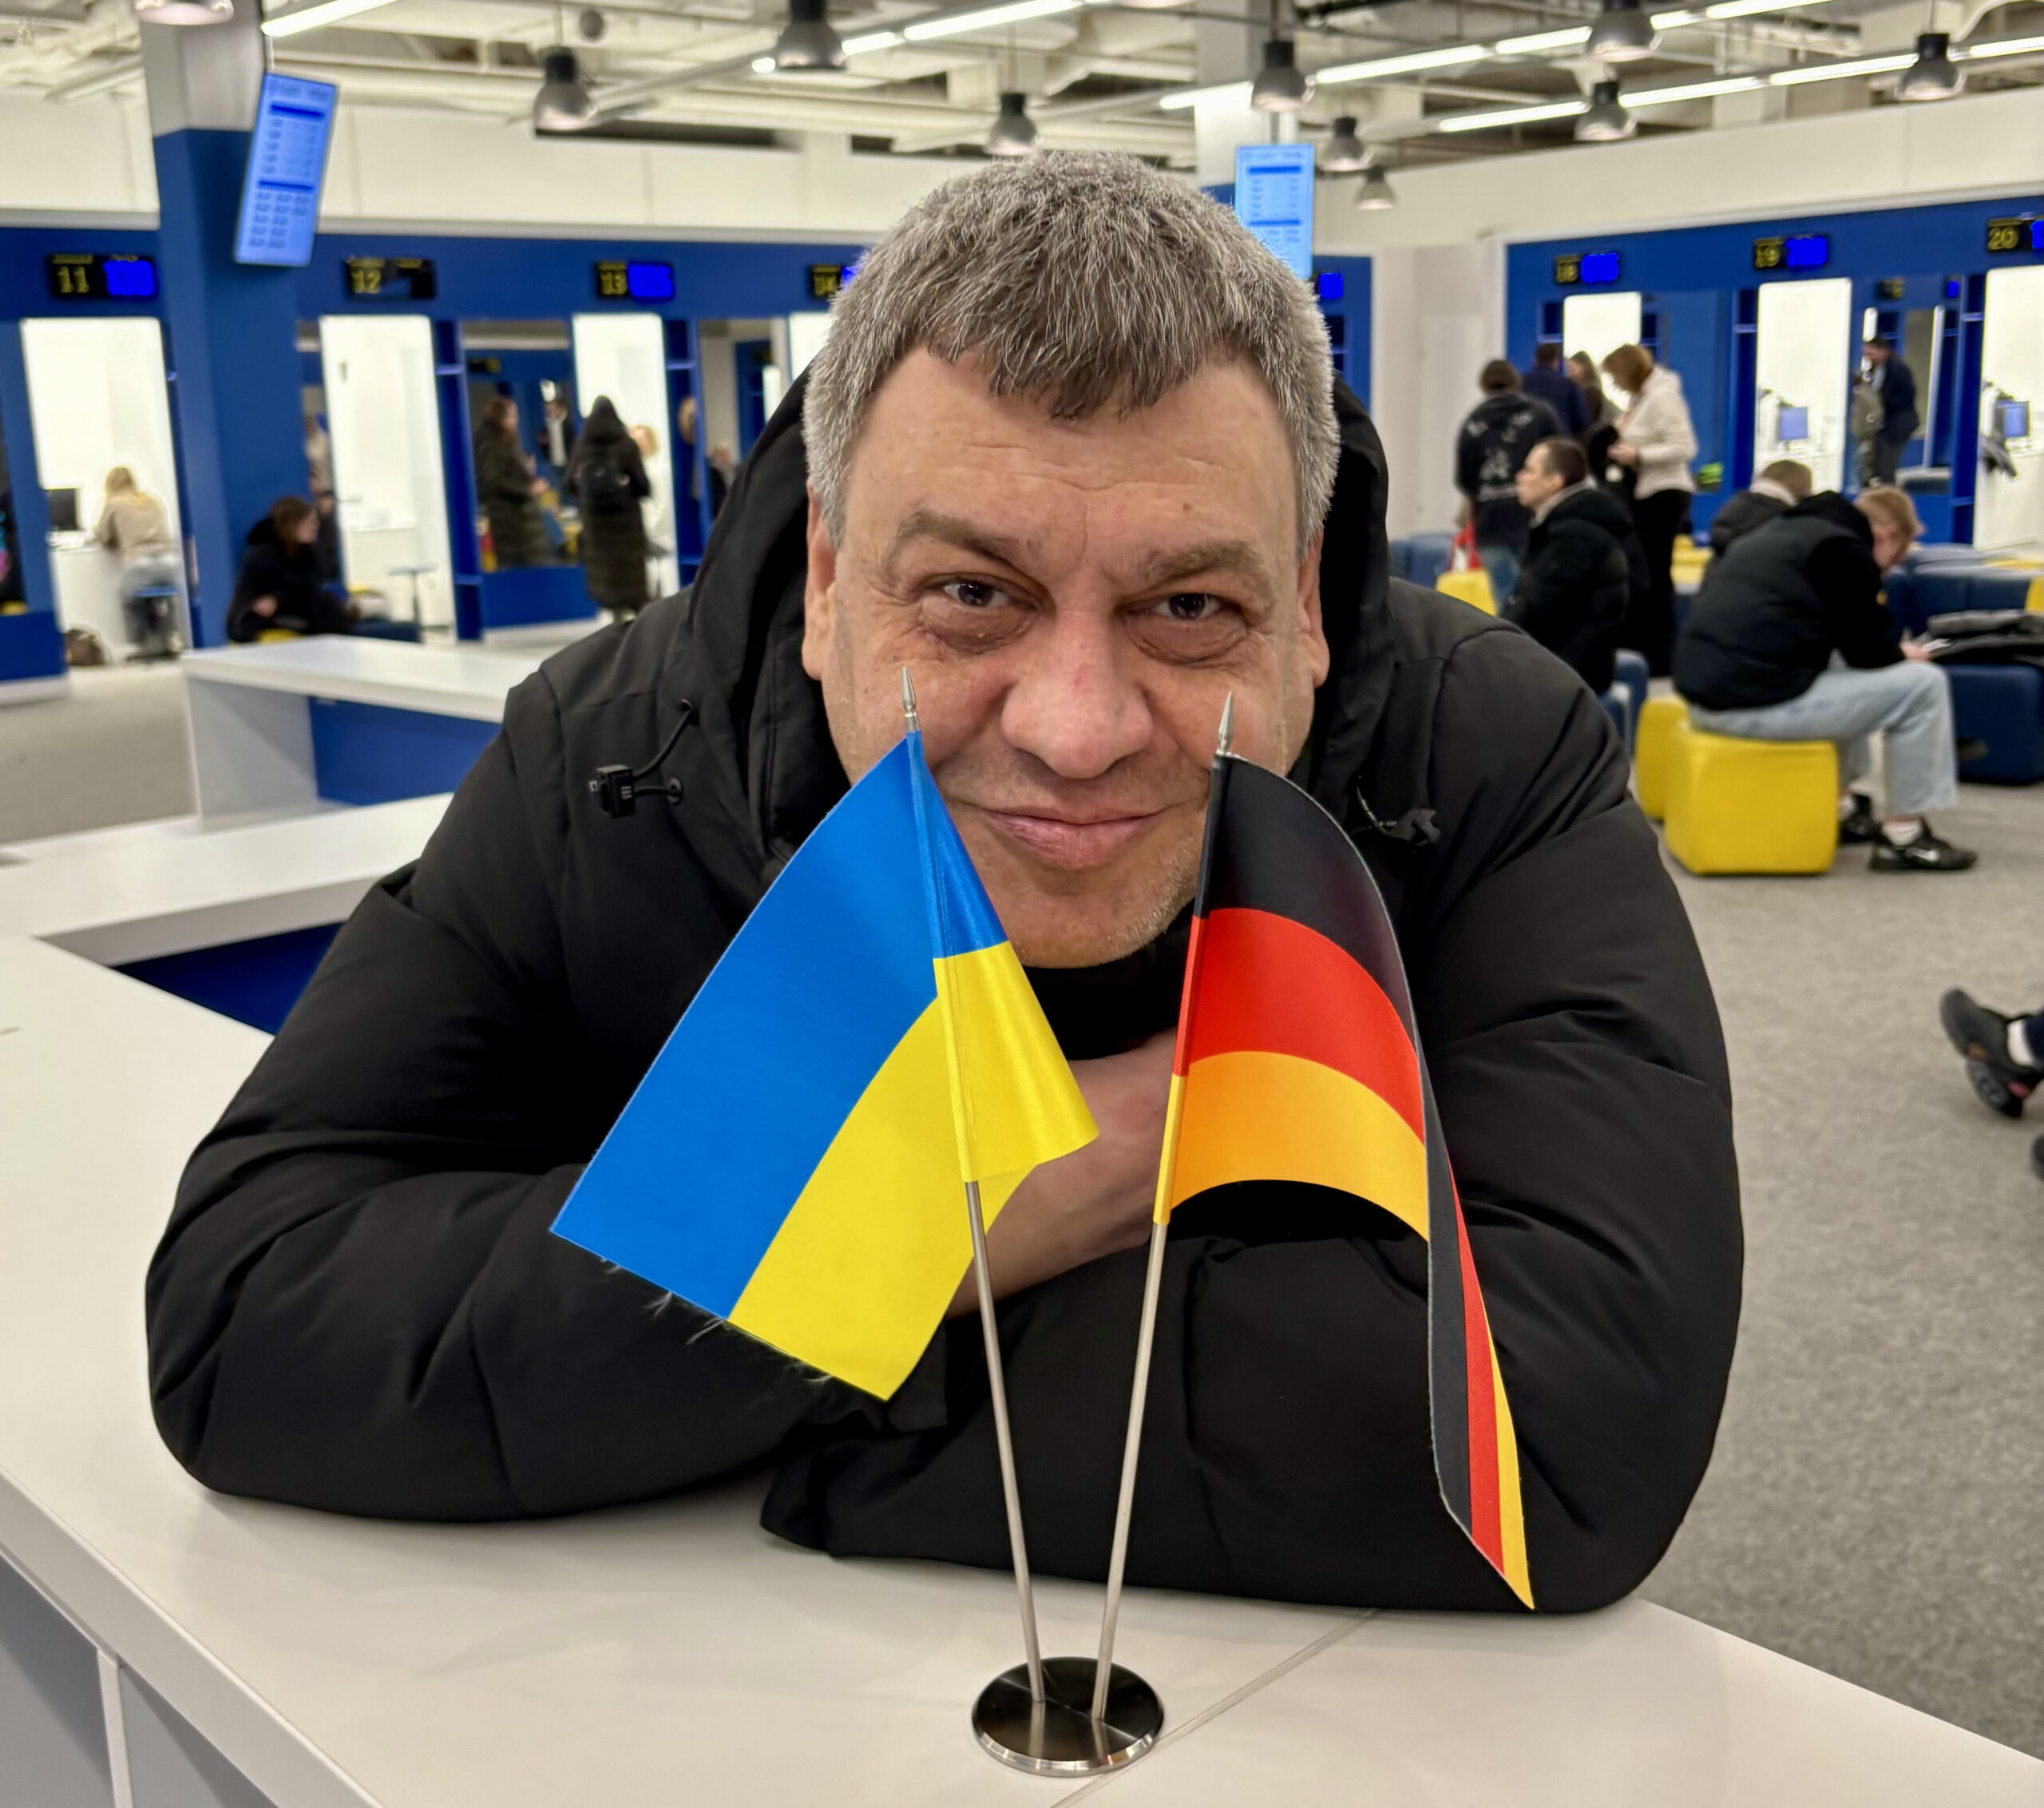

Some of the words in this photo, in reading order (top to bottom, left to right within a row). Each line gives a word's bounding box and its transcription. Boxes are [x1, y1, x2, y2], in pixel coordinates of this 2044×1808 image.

[1988, 227, 2018, 250] 20
[57, 266, 89, 293] 11
[352, 269, 382, 294] 12
